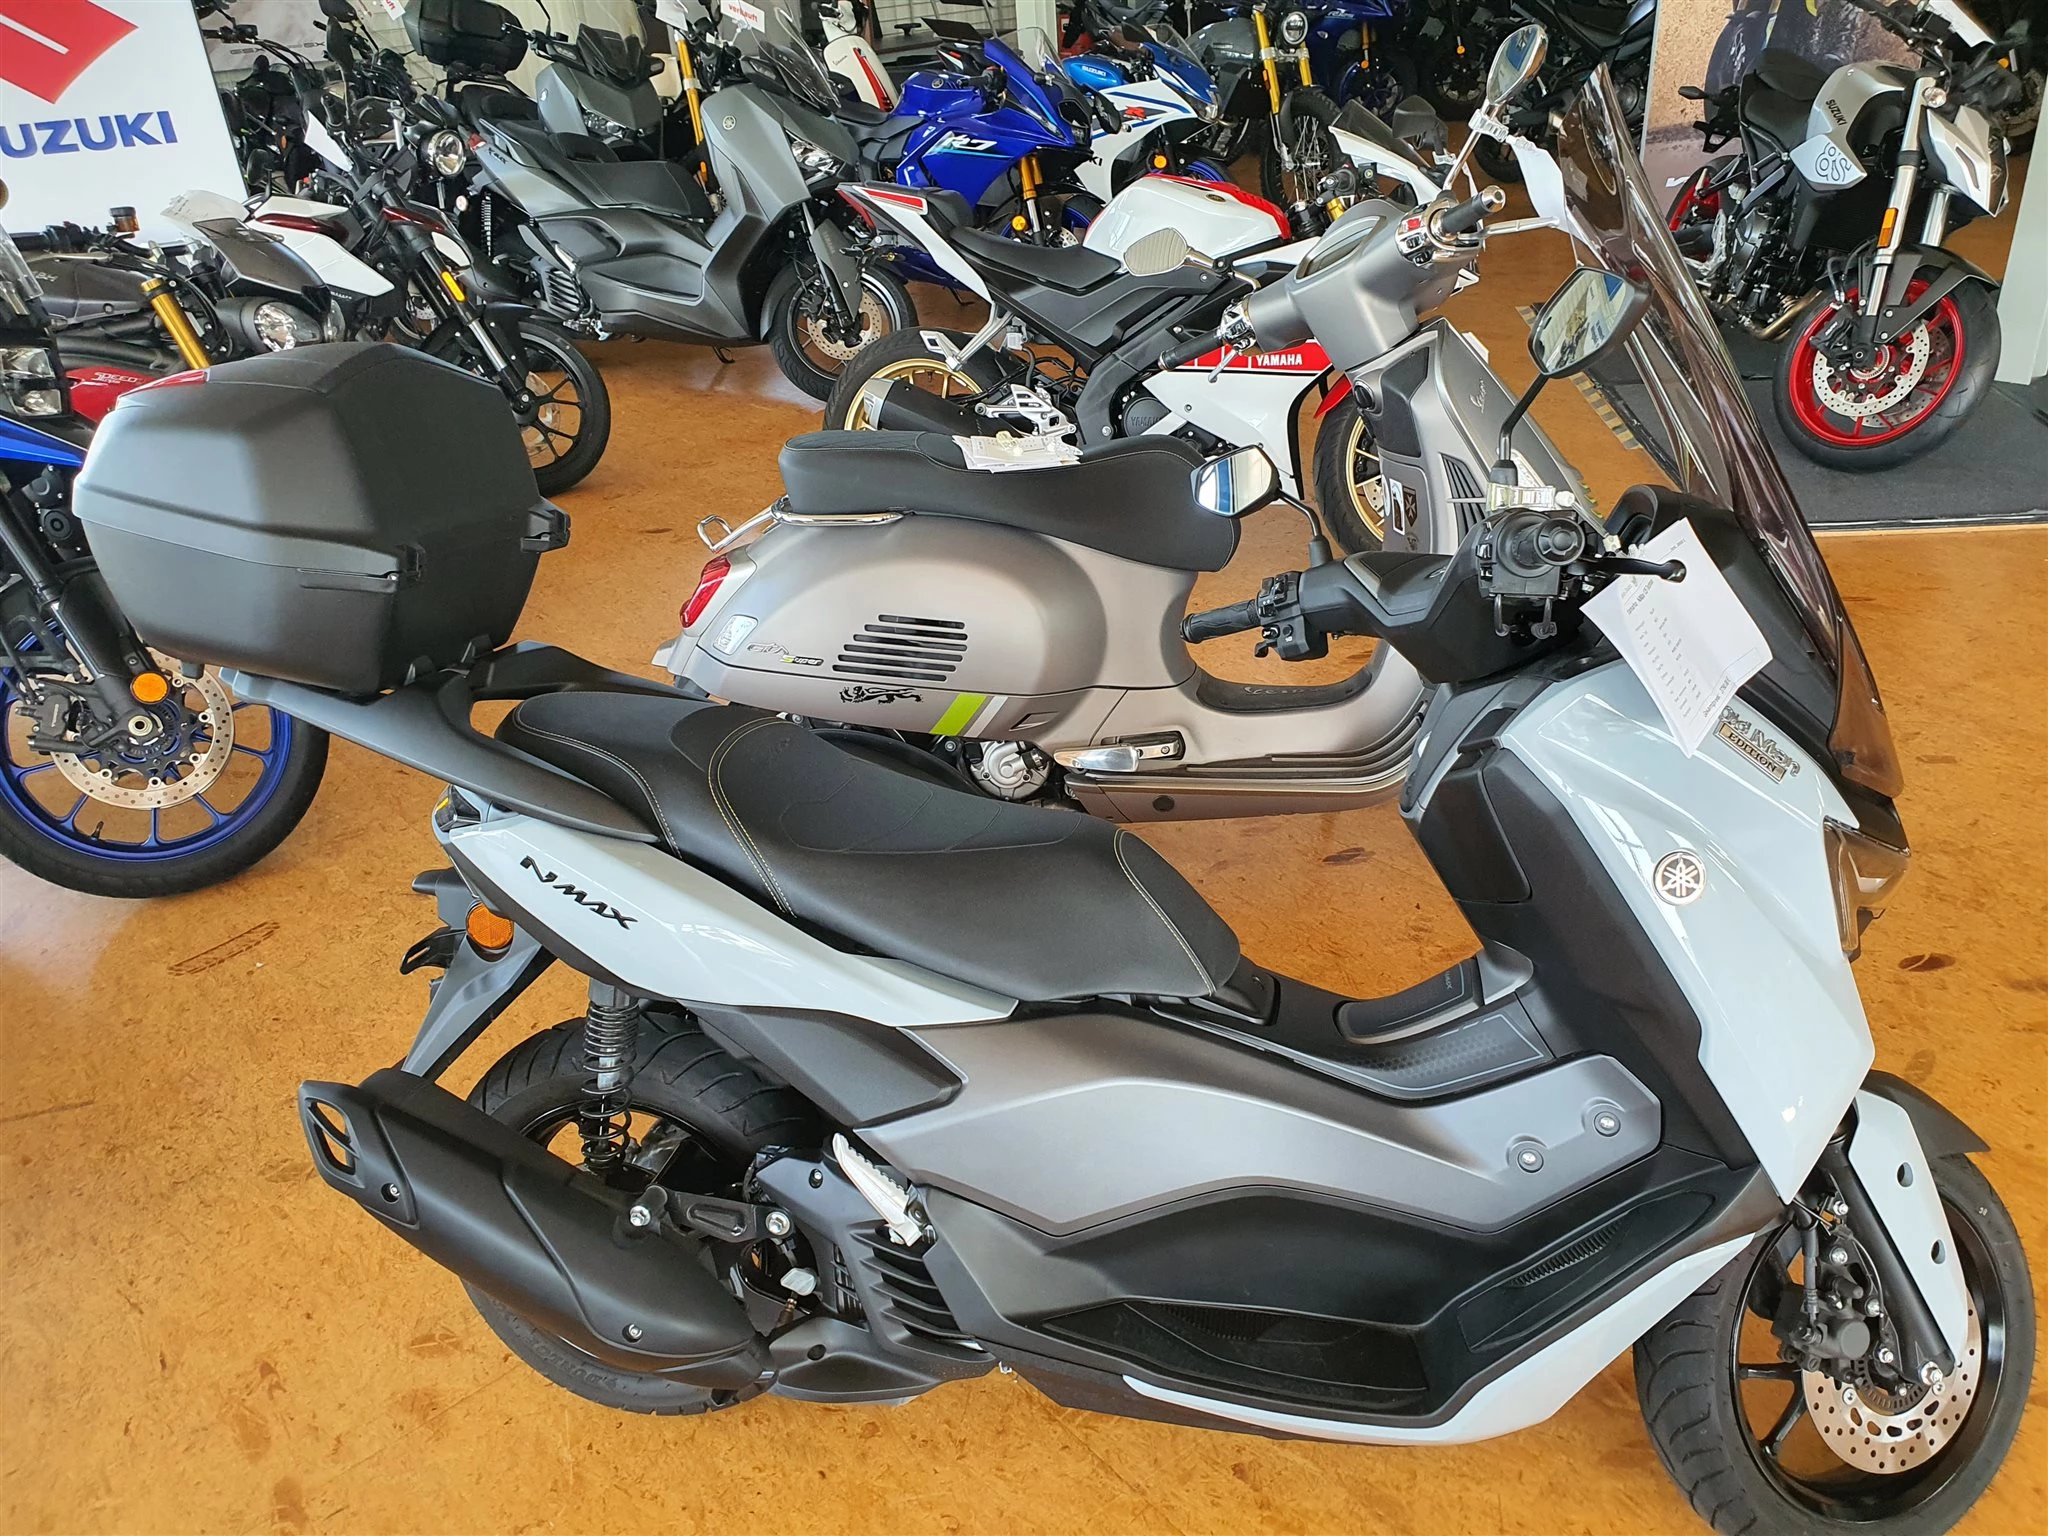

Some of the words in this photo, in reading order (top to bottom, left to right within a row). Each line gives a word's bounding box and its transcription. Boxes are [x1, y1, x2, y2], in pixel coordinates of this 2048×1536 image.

[1081, 65, 1107, 77] SUZUKI
[1825, 99, 1848, 126] SUZUKI
[0, 111, 179, 159] UZUKI
[1255, 353, 1303, 367] YAMAHA
[1727, 731, 1777, 773] EDITION
[519, 855, 639, 931] NMAX
